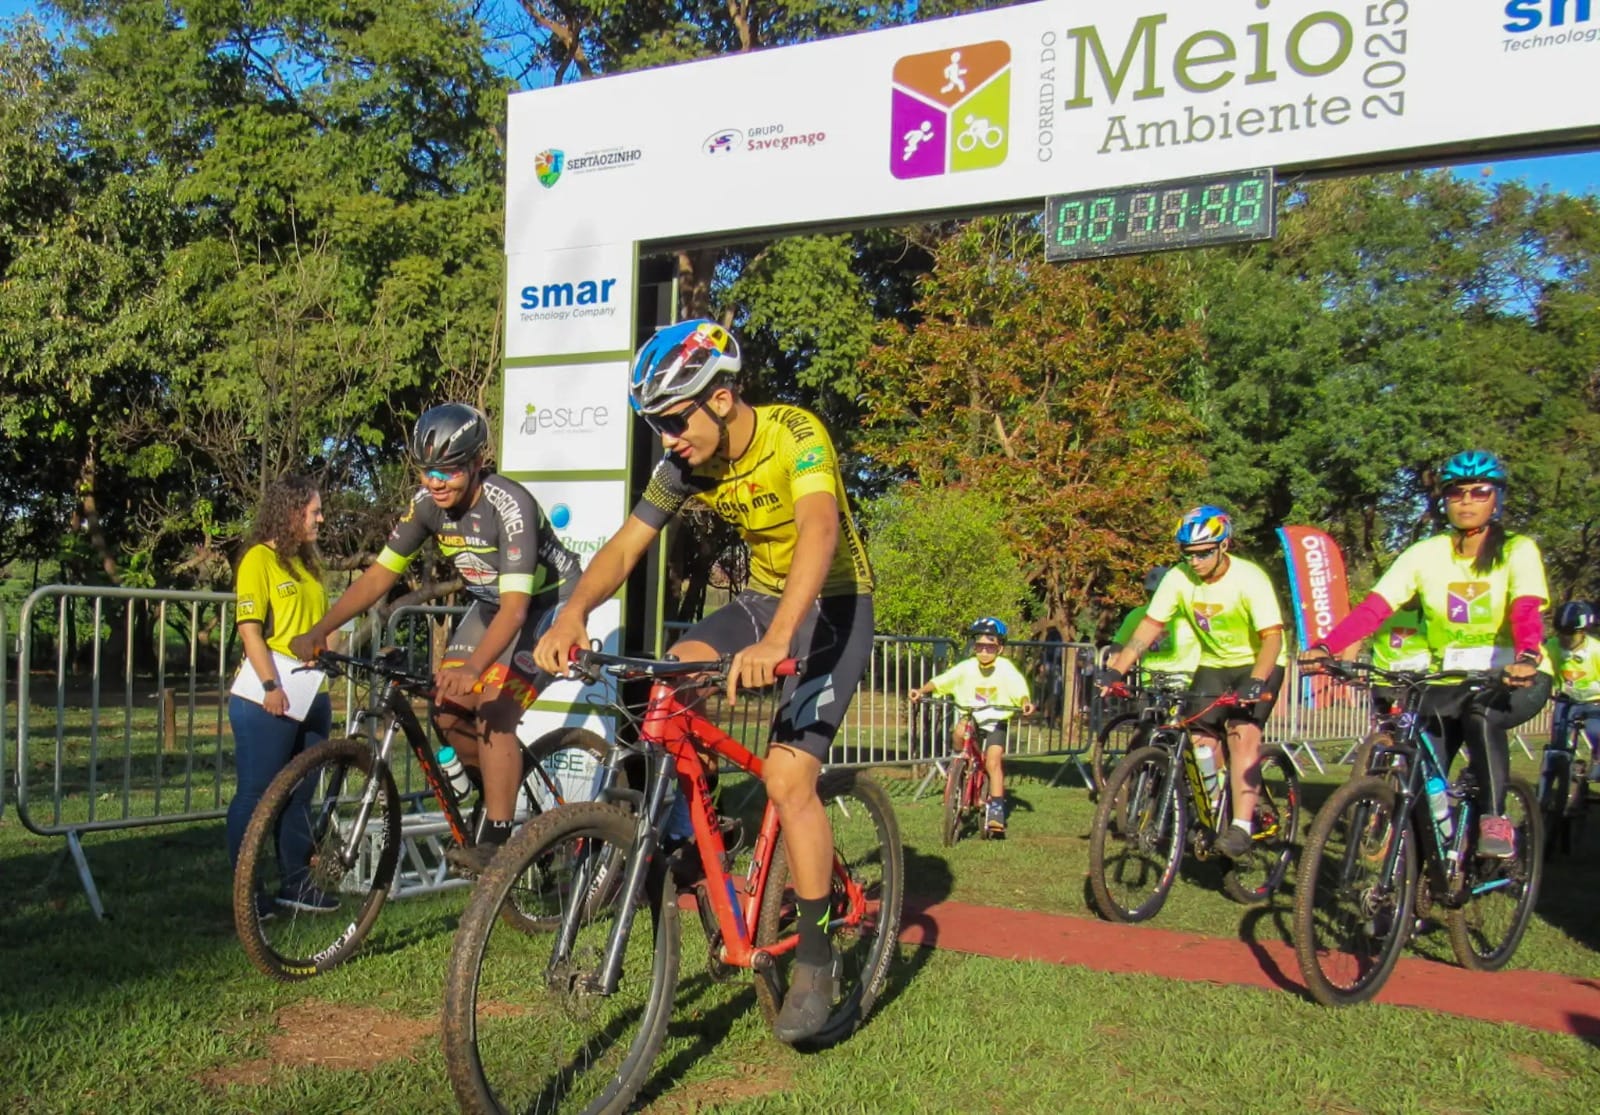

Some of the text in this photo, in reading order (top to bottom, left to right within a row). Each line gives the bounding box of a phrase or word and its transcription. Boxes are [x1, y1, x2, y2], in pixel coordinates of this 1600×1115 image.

[1064, 0, 1354, 110] Meio
[1362, 0, 1409, 119] 2025
[1502, 28, 1600, 52] Technolog
[1037, 30, 1057, 163] CORRIDA DO
[1097, 92, 1352, 155] Ambiente
[747, 131, 826, 152] Savegnago
[748, 124, 785, 138] GRUPO
[520, 278, 617, 310] smar
[520, 306, 616, 323] Technology Company
[482, 482, 525, 542] SERGOMEL
[1302, 535, 1332, 640] CORRENDO
